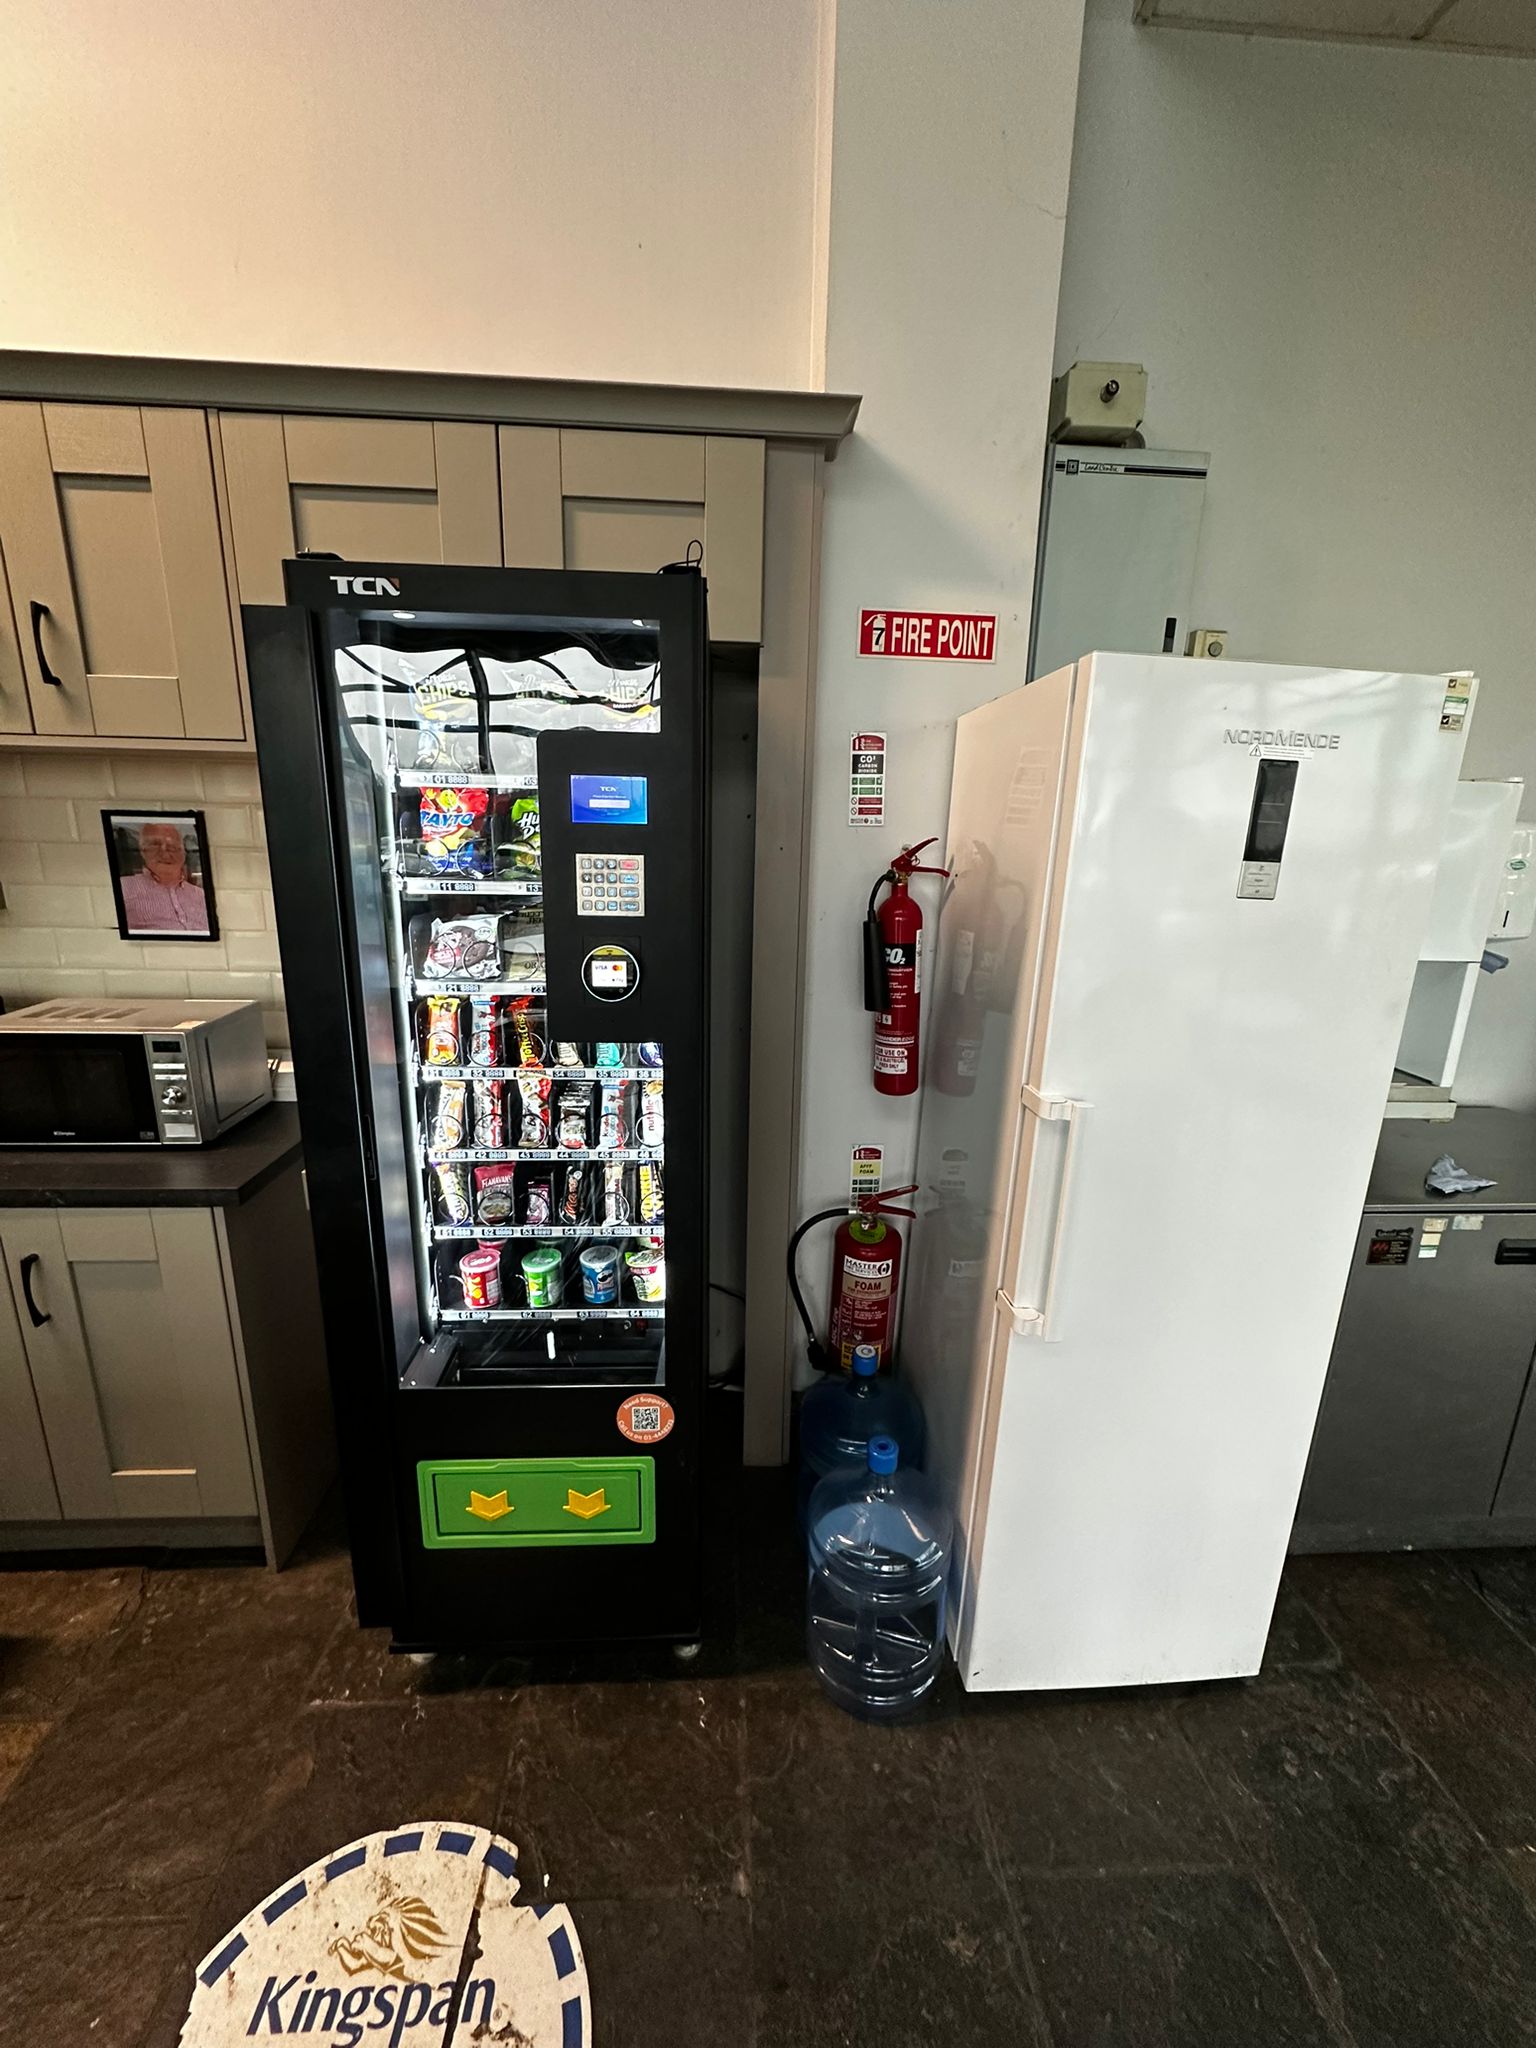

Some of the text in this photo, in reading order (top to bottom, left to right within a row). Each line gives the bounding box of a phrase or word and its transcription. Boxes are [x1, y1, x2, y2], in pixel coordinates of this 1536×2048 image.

[329, 575, 400, 596] TCN
[873, 617, 993, 656] 7 FIRE POINT
[1223, 729, 1340, 750] NORDMENDE
[420, 809, 475, 828] TAYTO
[527, 884, 540, 892] 13
[845, 1259, 878, 1270] MASTER
[855, 1281, 882, 1291] FOAM
[623, 1398, 640, 1410] Need
[246, 1970, 496, 2048] Kingspan
